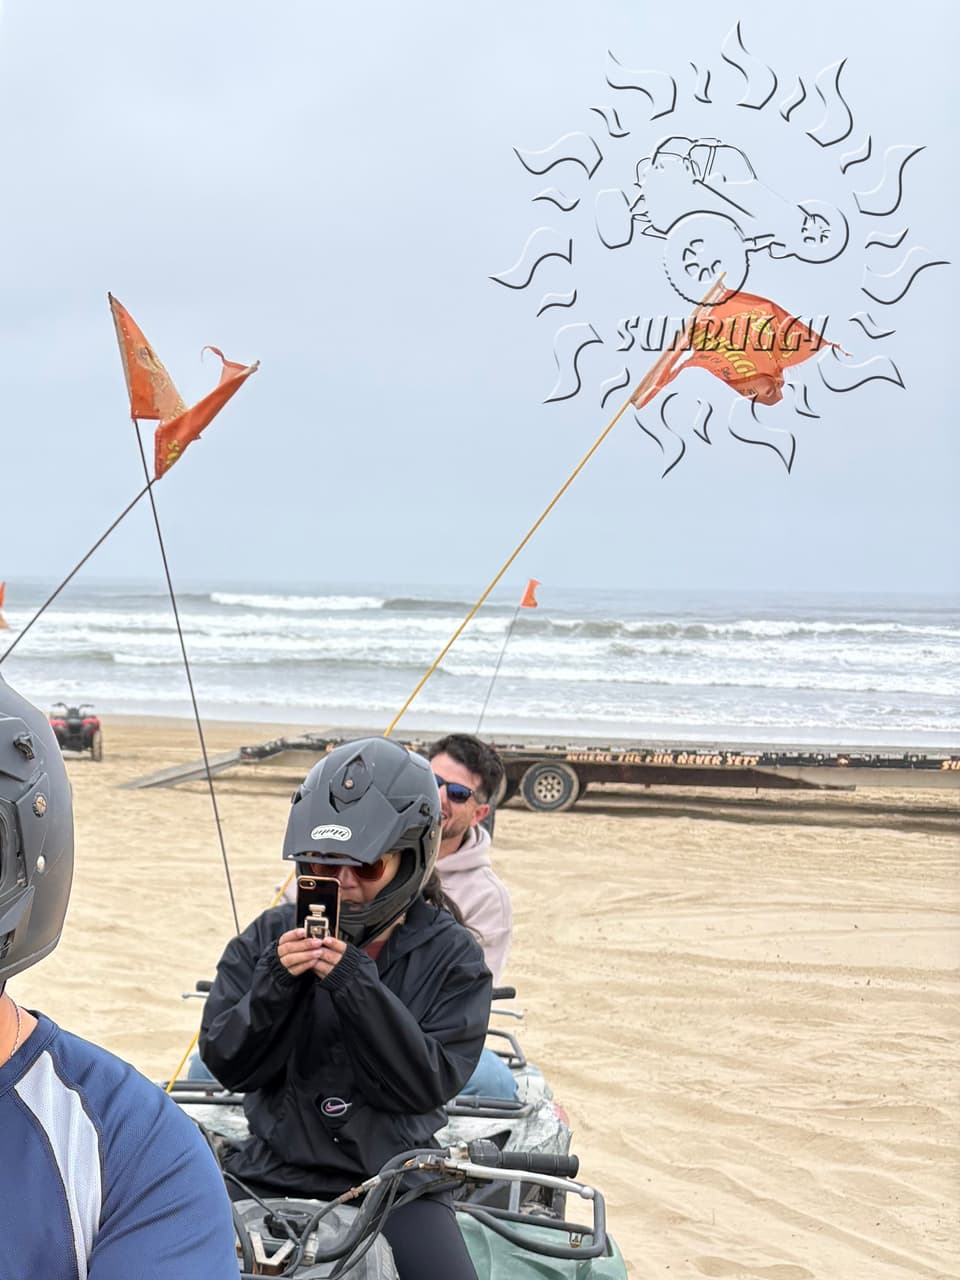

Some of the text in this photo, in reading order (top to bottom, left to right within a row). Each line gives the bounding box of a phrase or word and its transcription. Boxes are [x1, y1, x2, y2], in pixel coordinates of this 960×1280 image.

[645, 753, 674, 765] FUN
[677, 753, 723, 766] NEVER
[726, 754, 760, 767] SETS
